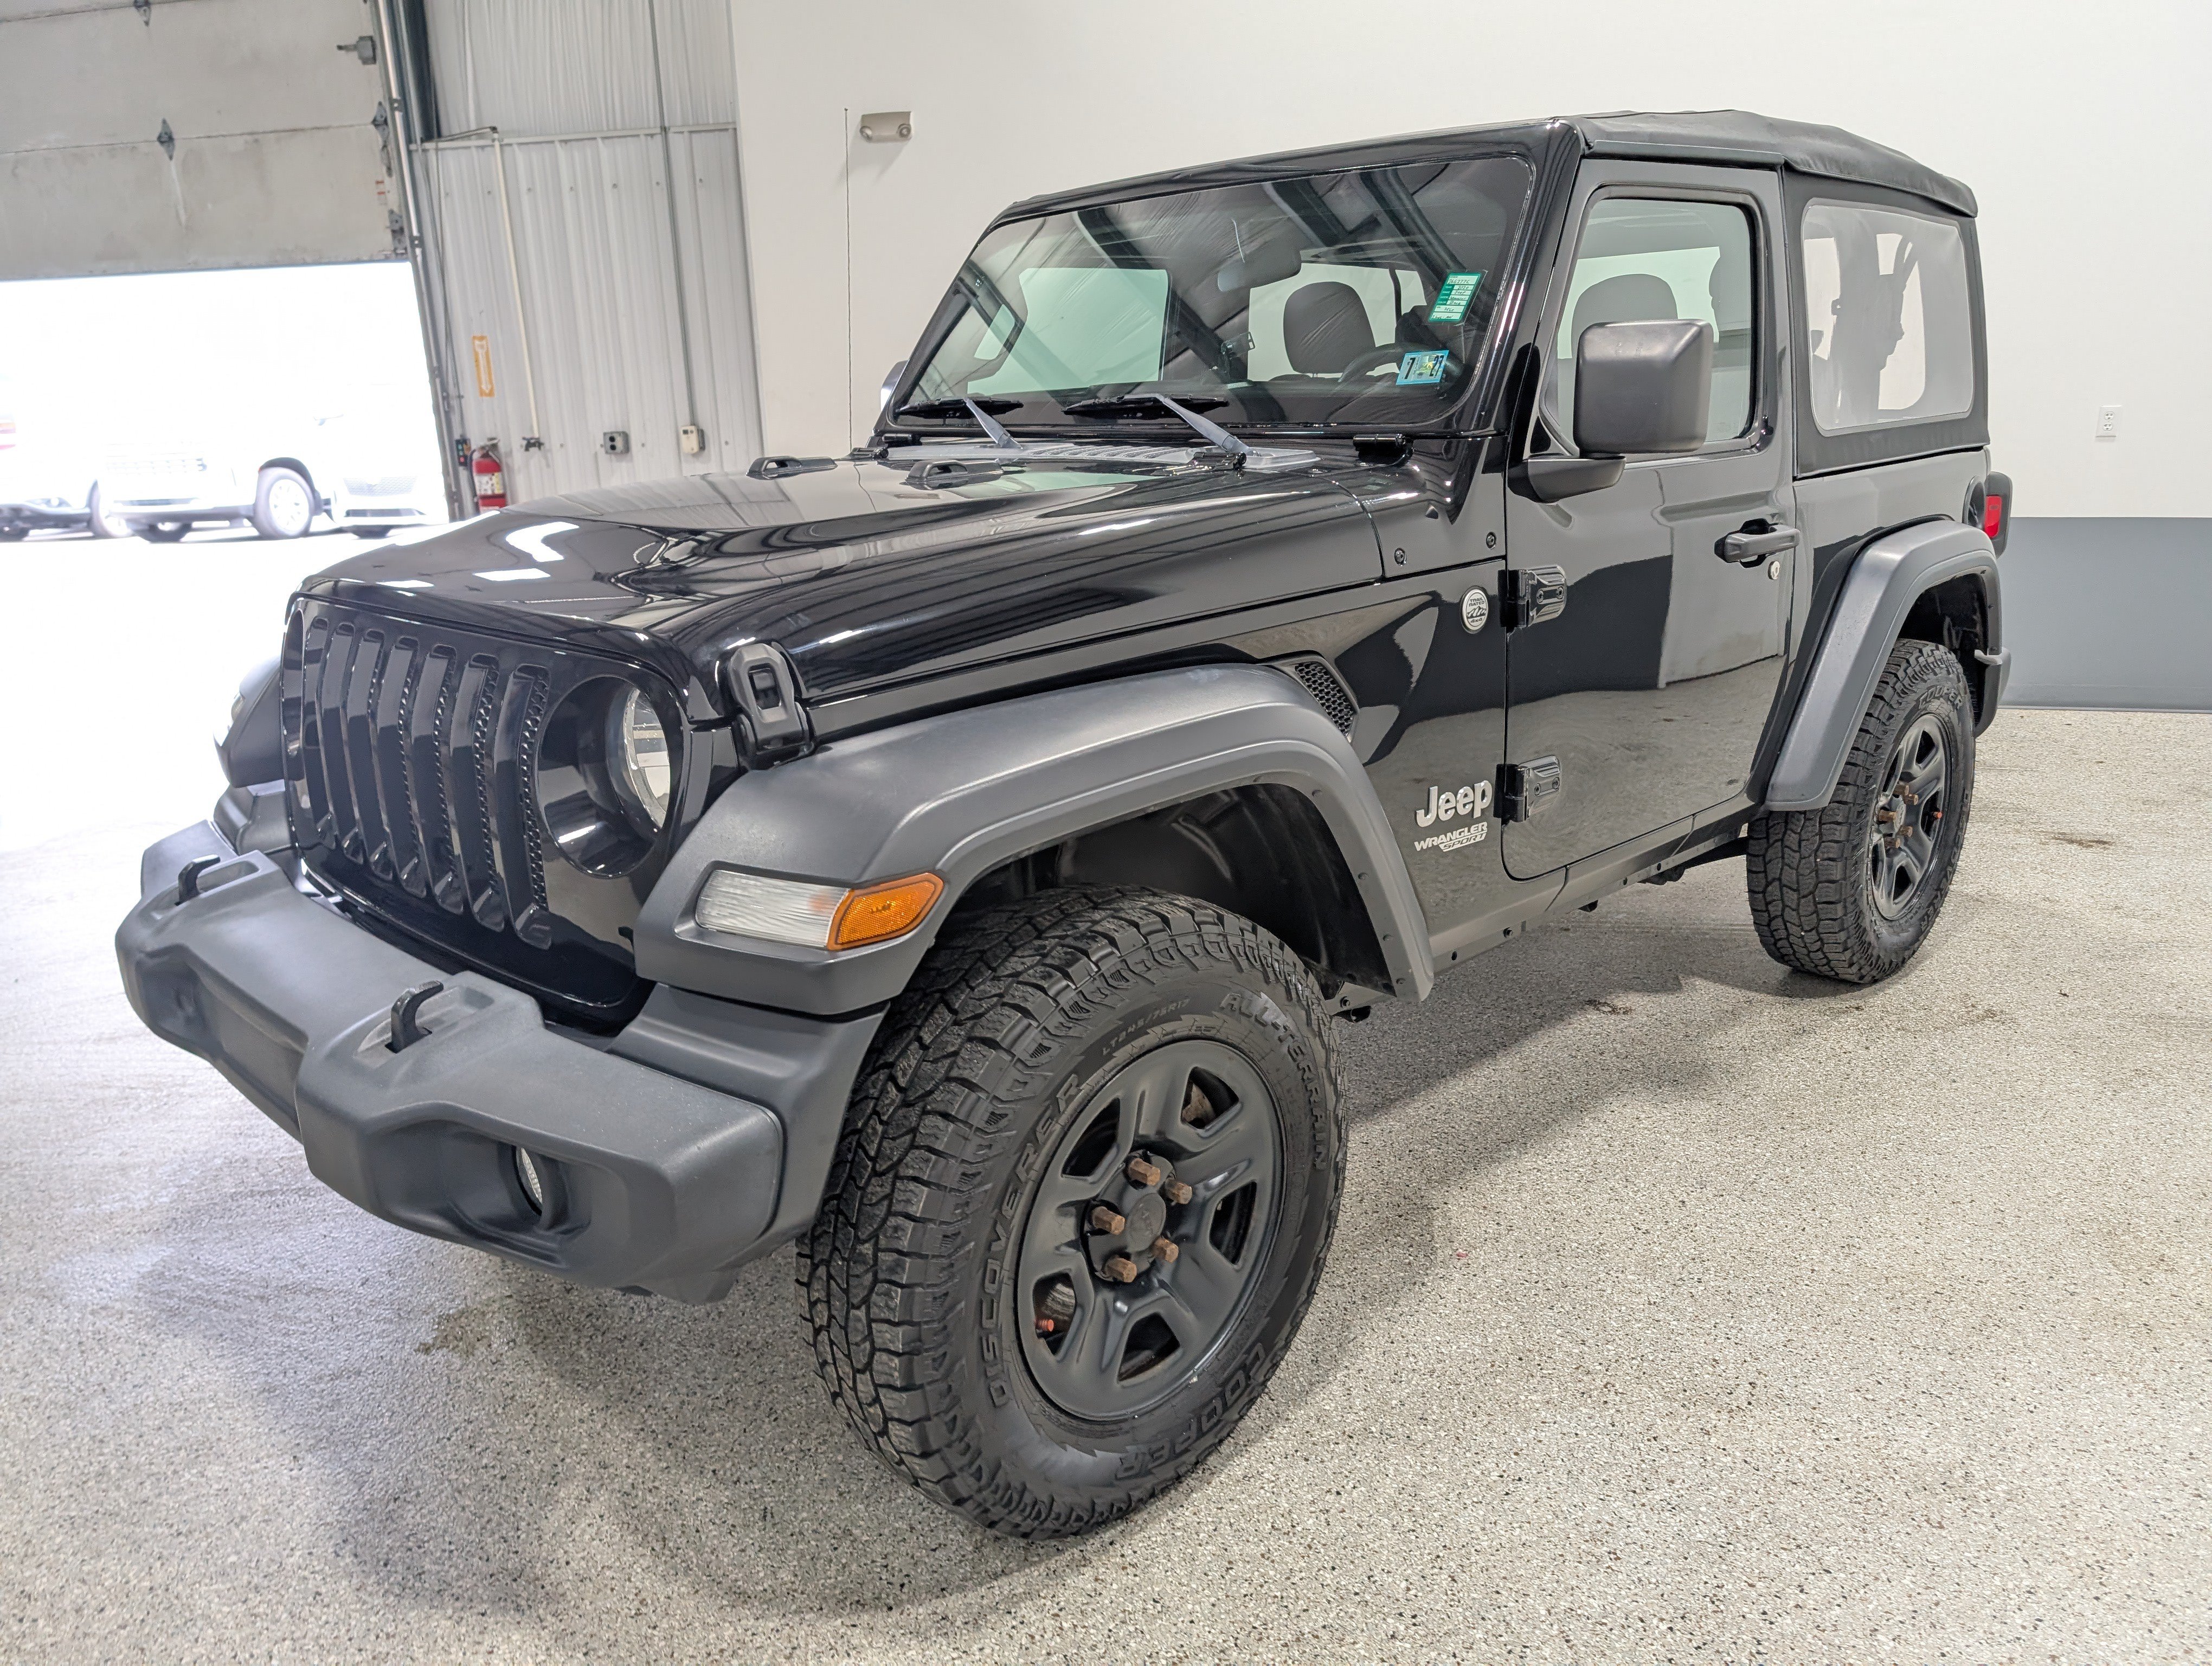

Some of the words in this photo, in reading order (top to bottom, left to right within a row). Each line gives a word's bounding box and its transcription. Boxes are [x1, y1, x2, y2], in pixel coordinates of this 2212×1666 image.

[1414, 780, 1493, 828] Jeep
[1414, 821, 1488, 851] WRANGLER
[1442, 833, 1486, 850] SPORT
[981, 1073, 1079, 1408] DISCOVERER
